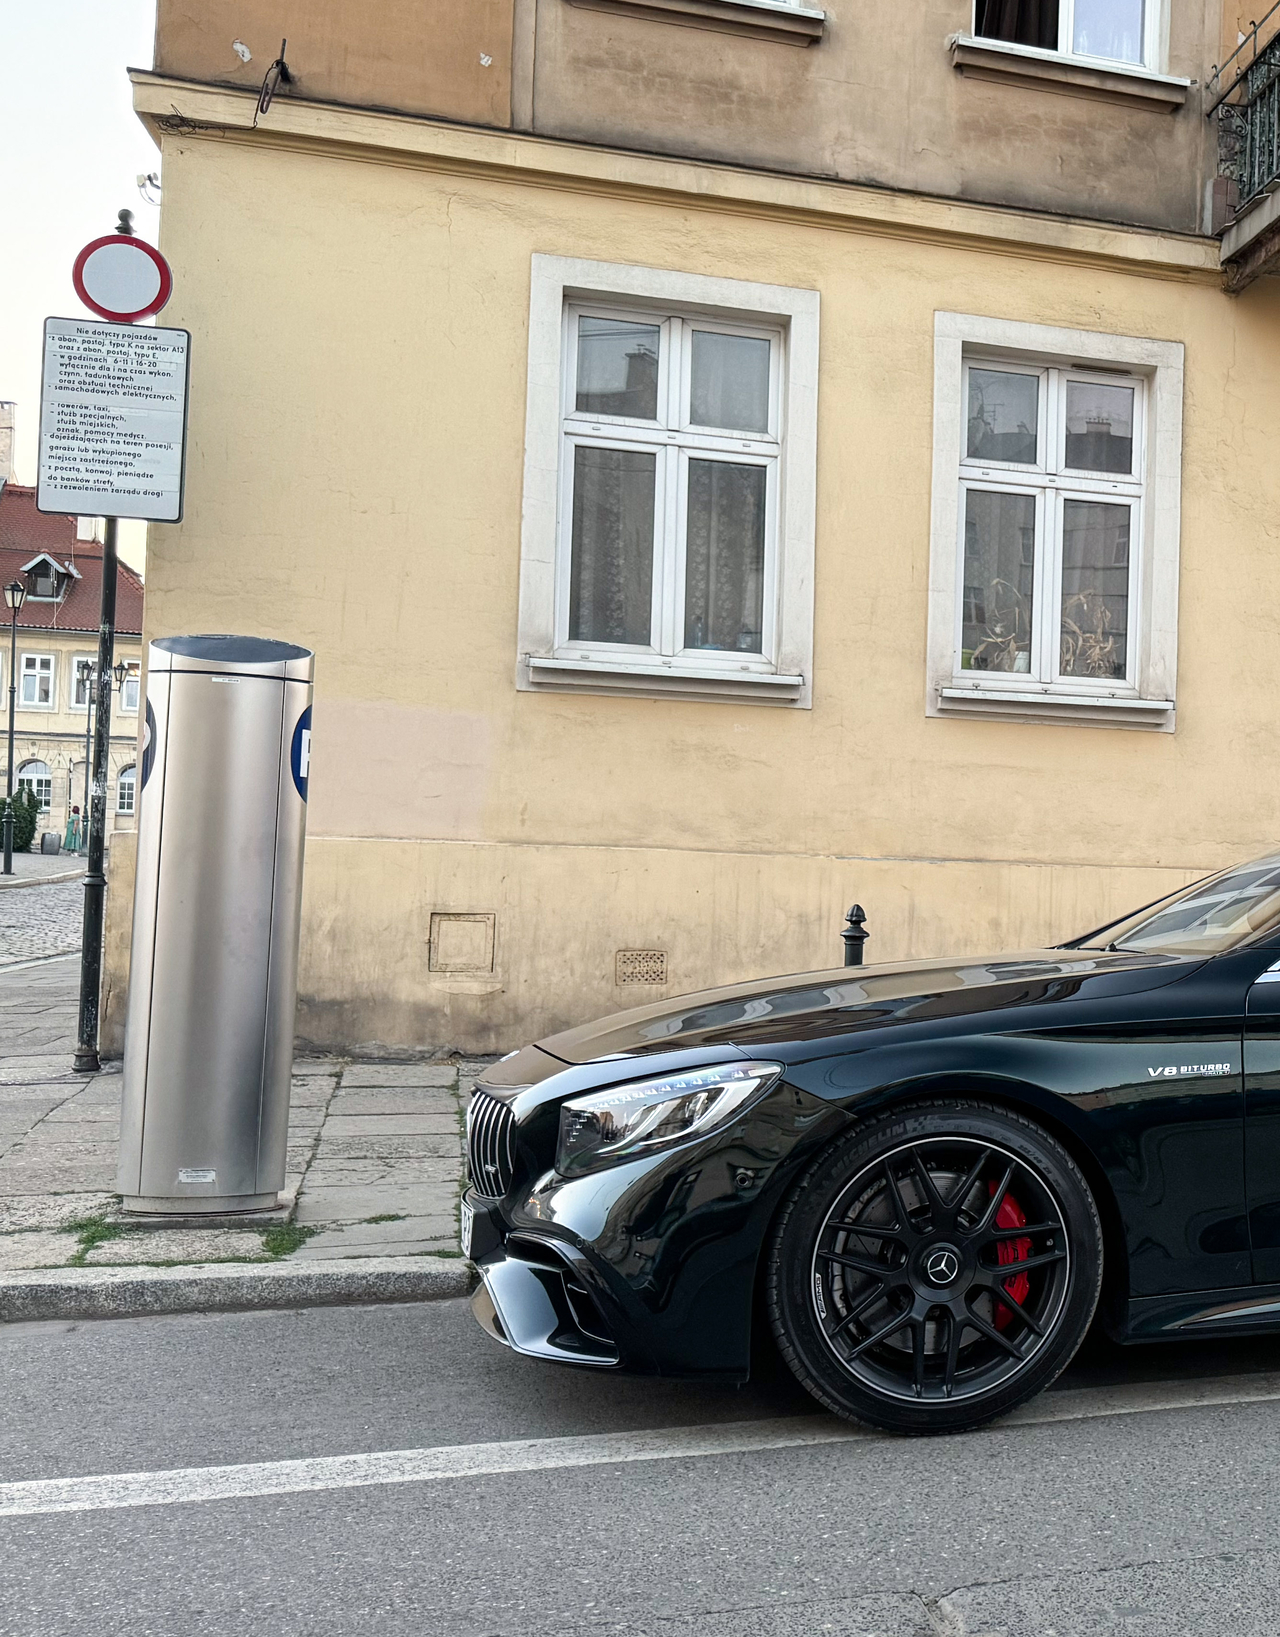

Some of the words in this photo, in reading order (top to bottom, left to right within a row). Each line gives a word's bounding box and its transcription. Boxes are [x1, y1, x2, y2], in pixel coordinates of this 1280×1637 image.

[92, 329, 120, 339] dotyczy
[122, 333, 158, 341] pojazdów
[68, 354, 108, 364] godzinach
[60, 362, 96, 370] wyłącznie
[85, 372, 134, 383] ładunkowych
[54, 385, 120, 396] samochodowych
[122, 390, 177, 401] elektrycznych,
[58, 403, 91, 411] rowerów,
[80, 413, 126, 422] specjalnych,
[79, 420, 118, 429] miejskich,
[50, 433, 108, 444] dojeżdżających
[84, 430, 114, 438] pomocy
[48, 453, 77, 462] miejsca
[92, 448, 142, 459] wykupionego
[117, 470, 154, 479] pieniądze
[60, 484, 108, 493] zezwoleniem
[143, 489, 163, 497] drogi
[1147, 1066, 1177, 1076] V8
[830, 1122, 905, 1178] MICHELIN
